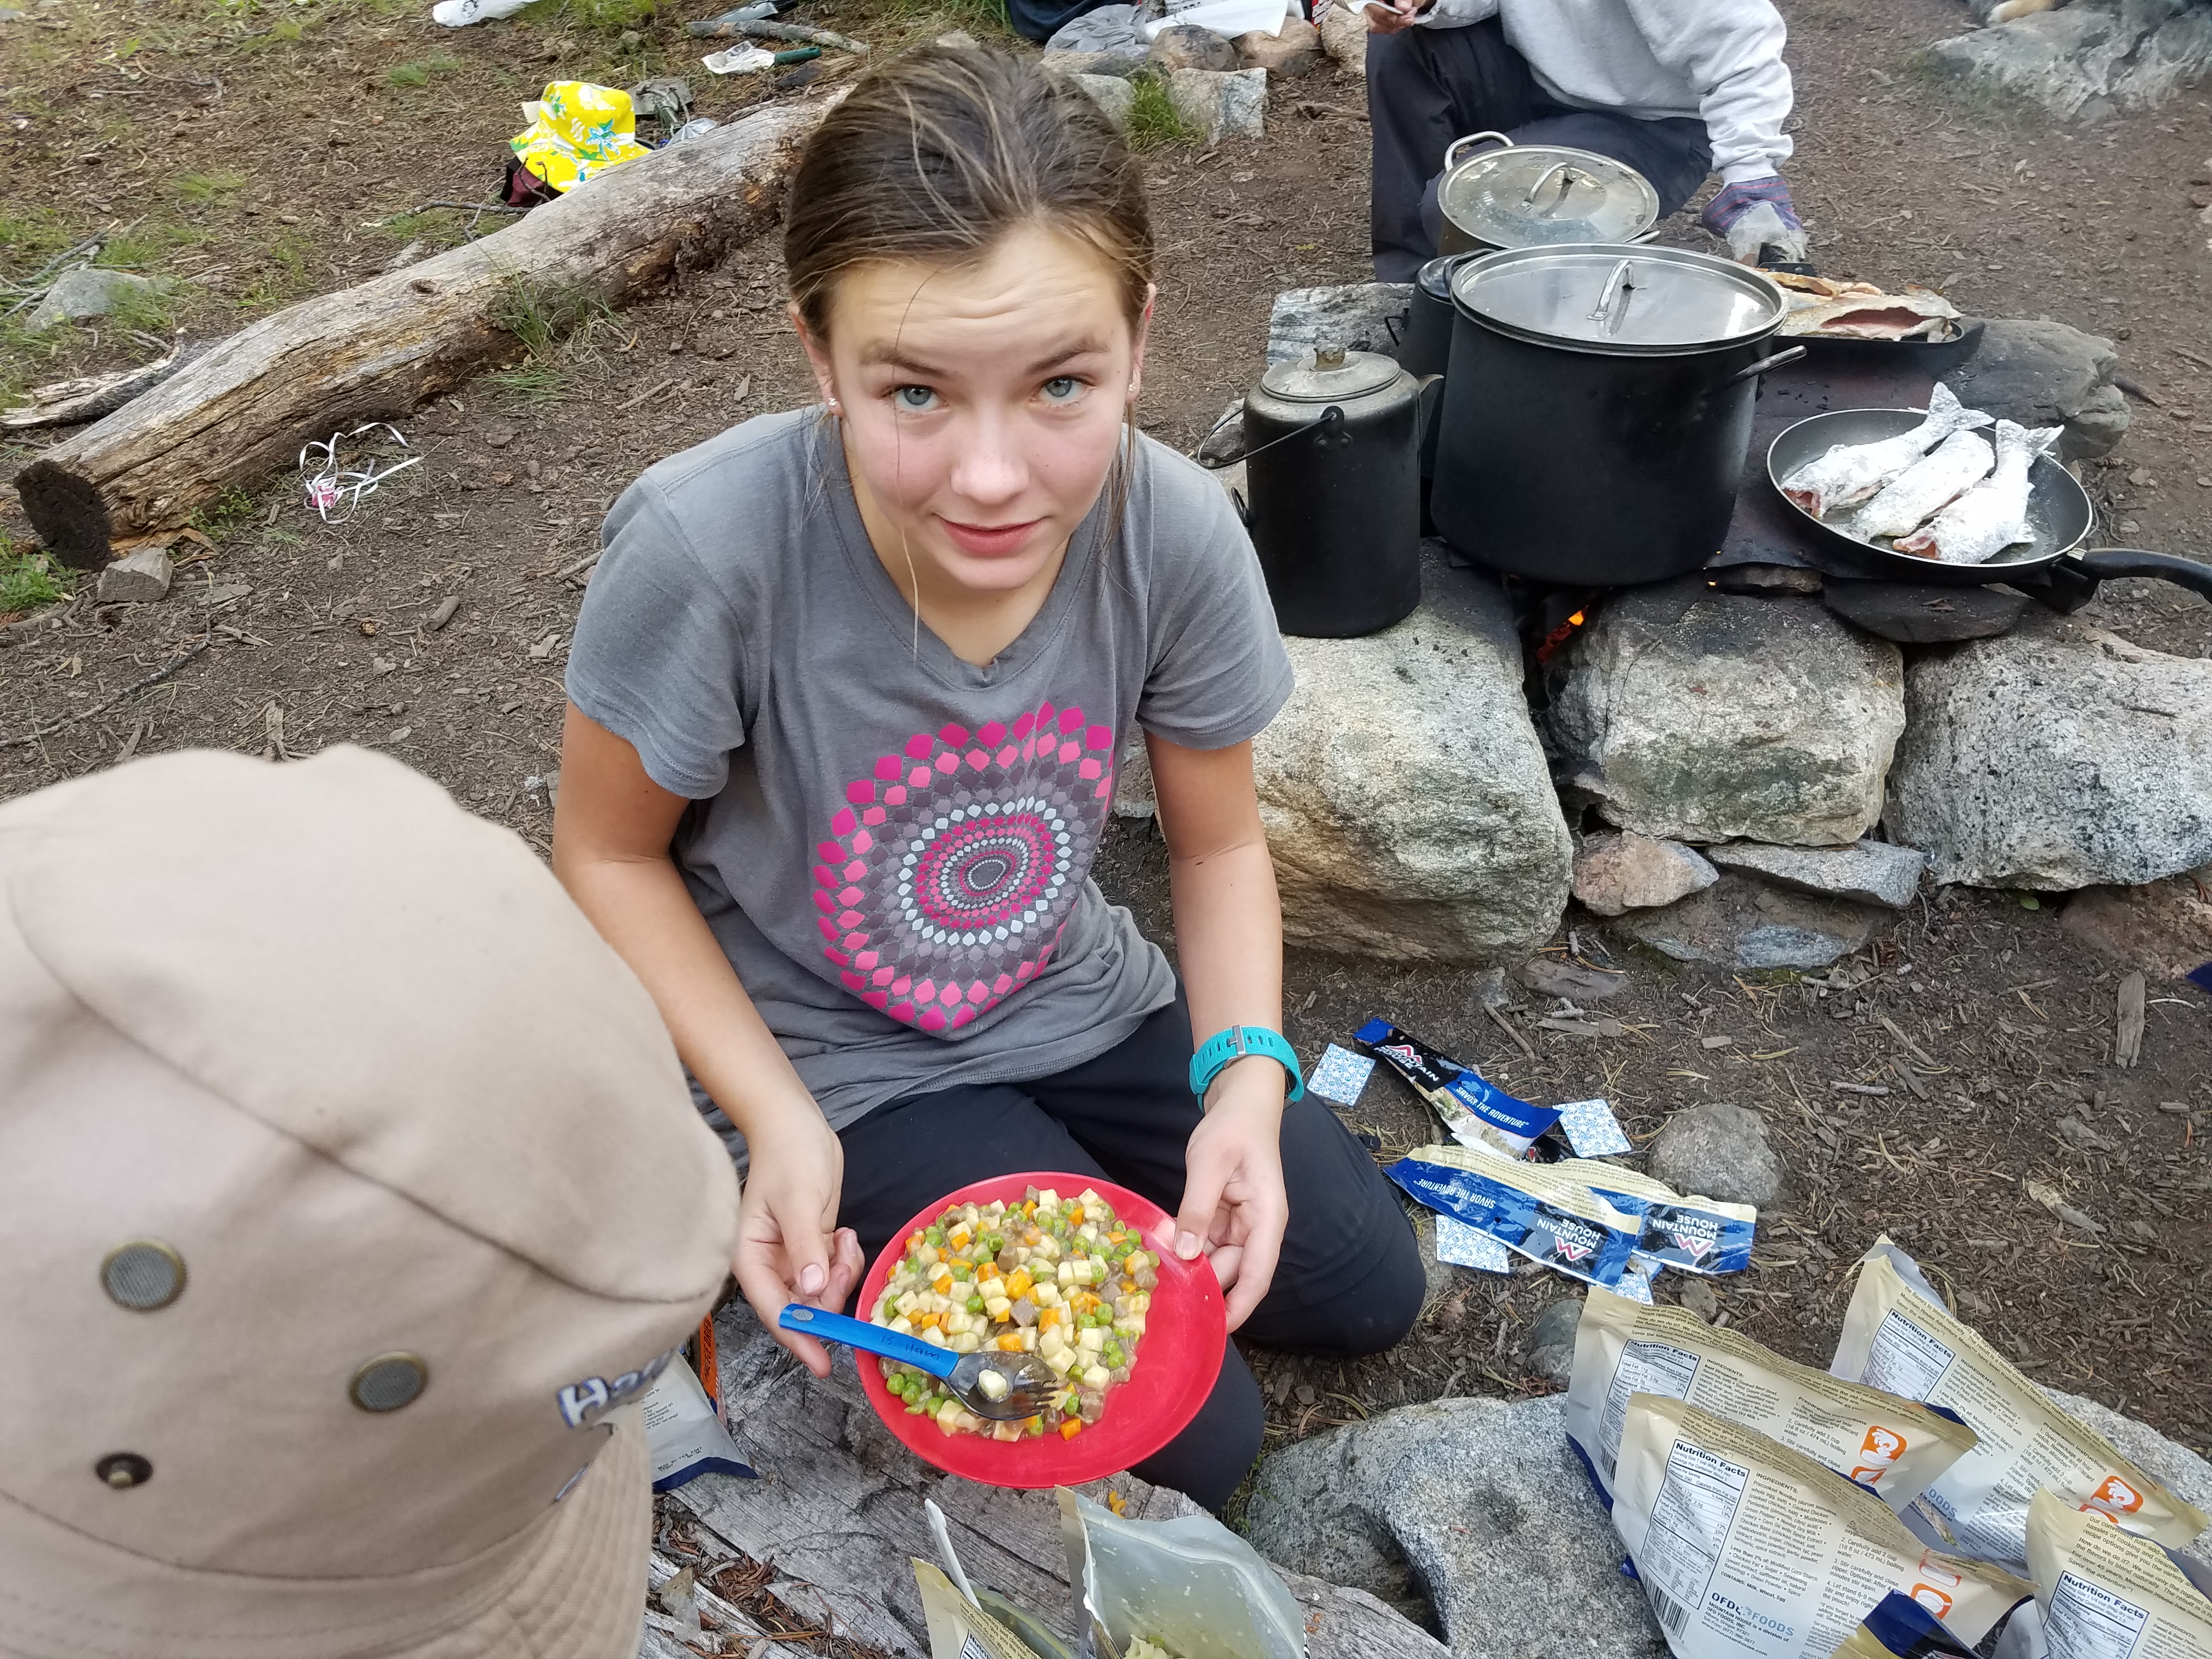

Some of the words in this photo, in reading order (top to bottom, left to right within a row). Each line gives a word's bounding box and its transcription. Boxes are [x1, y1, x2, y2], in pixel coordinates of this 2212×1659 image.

[1374, 1047, 1414, 1069] HOUSE
[1379, 1045, 1439, 1081] MOUNTAIN
[1457, 1087, 1477, 1105] SAVOR
[1476, 1103, 1488, 1113] THE
[1457, 1188, 1470, 1200] THE
[1470, 1193, 1496, 1209] SAVOR
[1537, 1218, 1596, 1249] MOUNTAIN
[1559, 1218, 1601, 1240] HOUSE
[1652, 1219, 1717, 1240] MOUNTAIN
[1677, 1215, 1718, 1231] HOUSE
[703, 1316, 712, 1345] DRIED
[1893, 1311, 1927, 1340] Nutrition
[1929, 1339, 1951, 1358] Facts
[1630, 1340, 1669, 1351] Nutrition
[1672, 1348, 1697, 1361] Facts
[1677, 1431, 1692, 1440] Savor
[1794, 1420, 1815, 1433] Carefully
[1796, 1443, 1817, 1456] carefully
[1827, 1459, 1841, 1468] close
[1830, 1443, 1846, 1454] boiling
[1676, 1443, 1717, 1464] Nutrition
[1719, 1462, 1745, 1477] Facts
[2032, 1448, 2052, 1466] Carefully
[2051, 1465, 2061, 1473] add
[2063, 1476, 2073, 1485] cup
[1848, 1538, 1870, 1551] Carefully
[2086, 1523, 2109, 1535] hassles
[2117, 1537, 2141, 1553] cooking
[2141, 1550, 2154, 1559] and
[2154, 1558, 2181, 1572] cleanup.
[1886, 1560, 1904, 1572] boiling
[2068, 1558, 2084, 1568] Savor
[2079, 1537, 2092, 1547] How
[2143, 1570, 2154, 1578] use
[2155, 1577, 2168, 1585] only
[2169, 1583, 2179, 1592] the
[2083, 1530, 2101, 1540] recipe
[2102, 1538, 2124, 1552] options
[2125, 1550, 2138, 1559] give
[2139, 1557, 2151, 1566] you
[2163, 1570, 2183, 1583] variety
[2185, 1581, 2198, 1590] and
[1830, 1571, 1850, 1581] minutes
[1850, 1565, 1872, 1577] carefully
[1885, 1578, 1899, 1587] close
[2086, 1548, 2106, 1561] flavors
[2115, 1562, 2132, 1575] blend
[2164, 1587, 2175, 1596] The
[1842, 1587, 1857, 1595] stand
[1873, 1580, 1886, 1589] After
[1831, 1596, 1850, 1607] pouch!
[1846, 1595, 1859, 1605] enjoy
[1860, 1601, 1873, 1610] right
[2062, 1575, 2111, 1602] Nutrition
[2114, 1599, 2144, 1618] Facts
[1708, 1601, 1734, 1617] MOUNTAIN
[1735, 1616, 1752, 1626] HOUSE
[1763, 1629, 1782, 1639] division
[1712, 1593, 1735, 1609] OFD
[1752, 1612, 1795, 1636] FOODS
[1717, 1612, 1734, 1623] FOODS,
